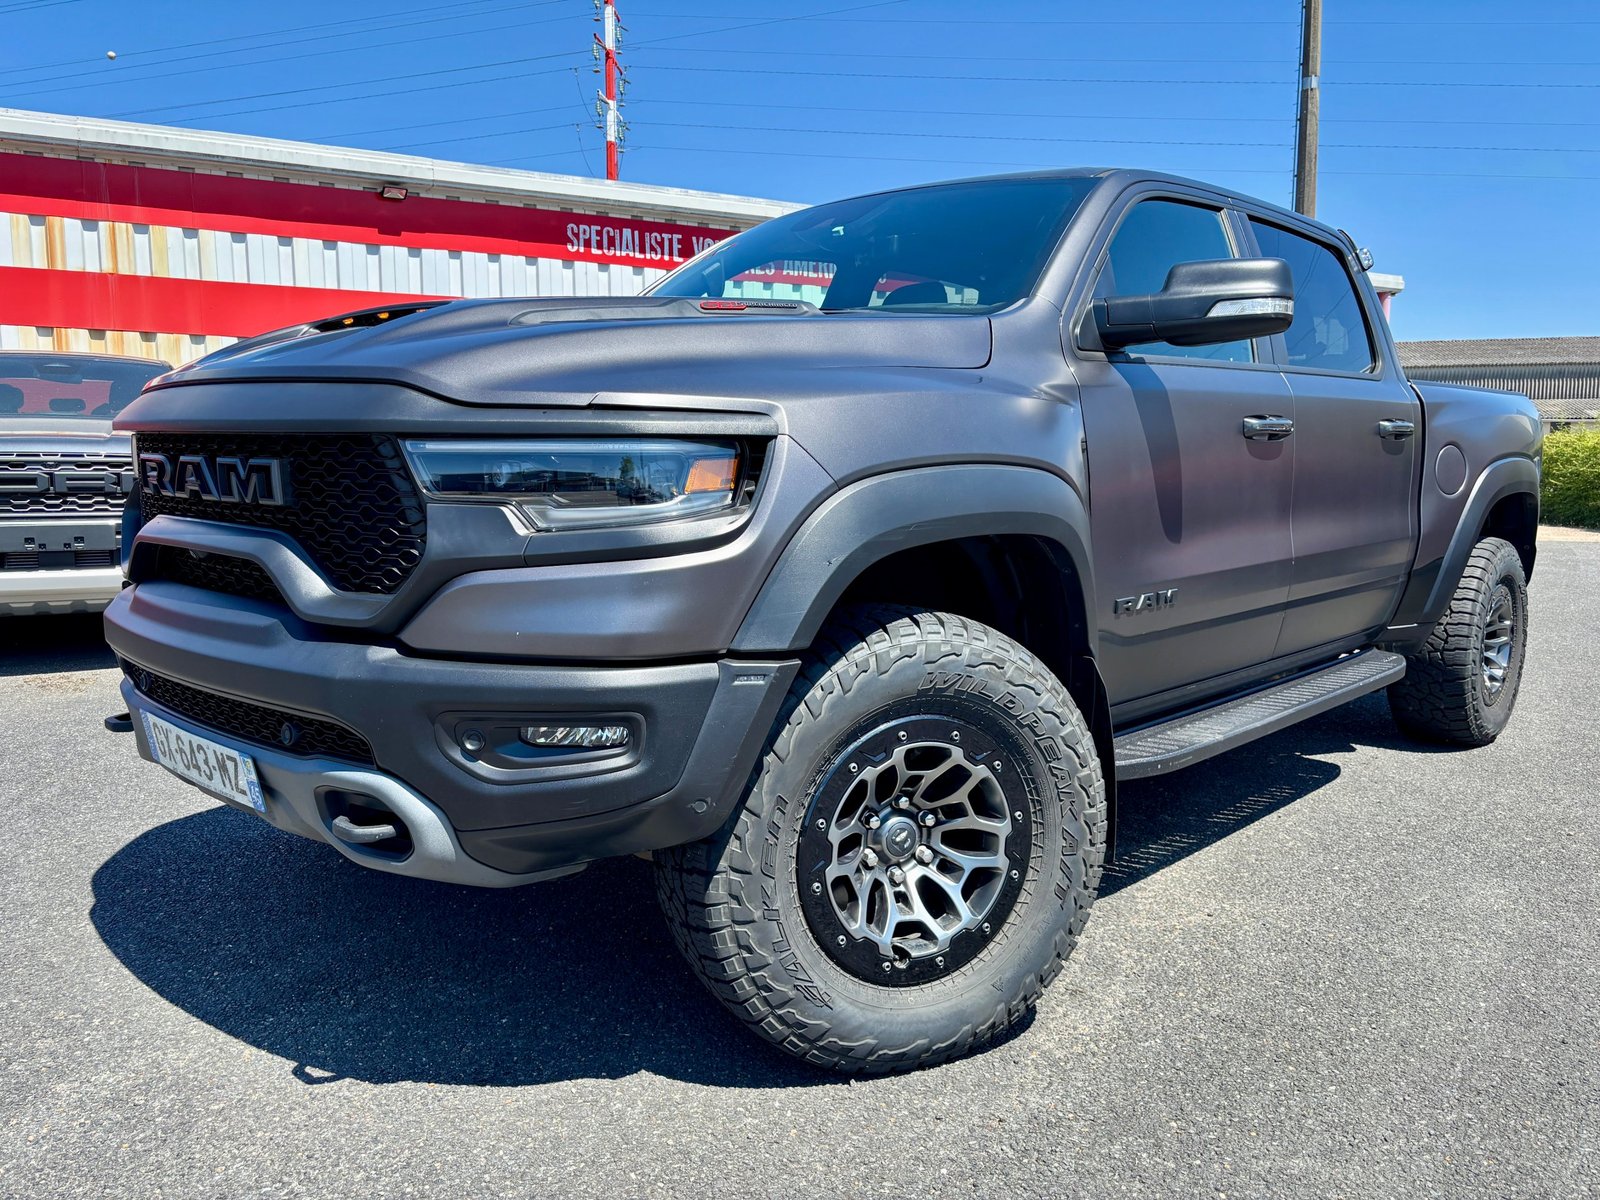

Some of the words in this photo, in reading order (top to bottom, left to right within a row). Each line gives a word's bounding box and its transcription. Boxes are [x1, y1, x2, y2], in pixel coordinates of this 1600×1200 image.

[566, 223, 684, 262] SPECIALISTE
[139, 453, 284, 506] RAM
[1113, 588, 1178, 614] RAM
[152, 721, 248, 797] GX-643-MZ
[918, 671, 1078, 821] WILDPEAK
